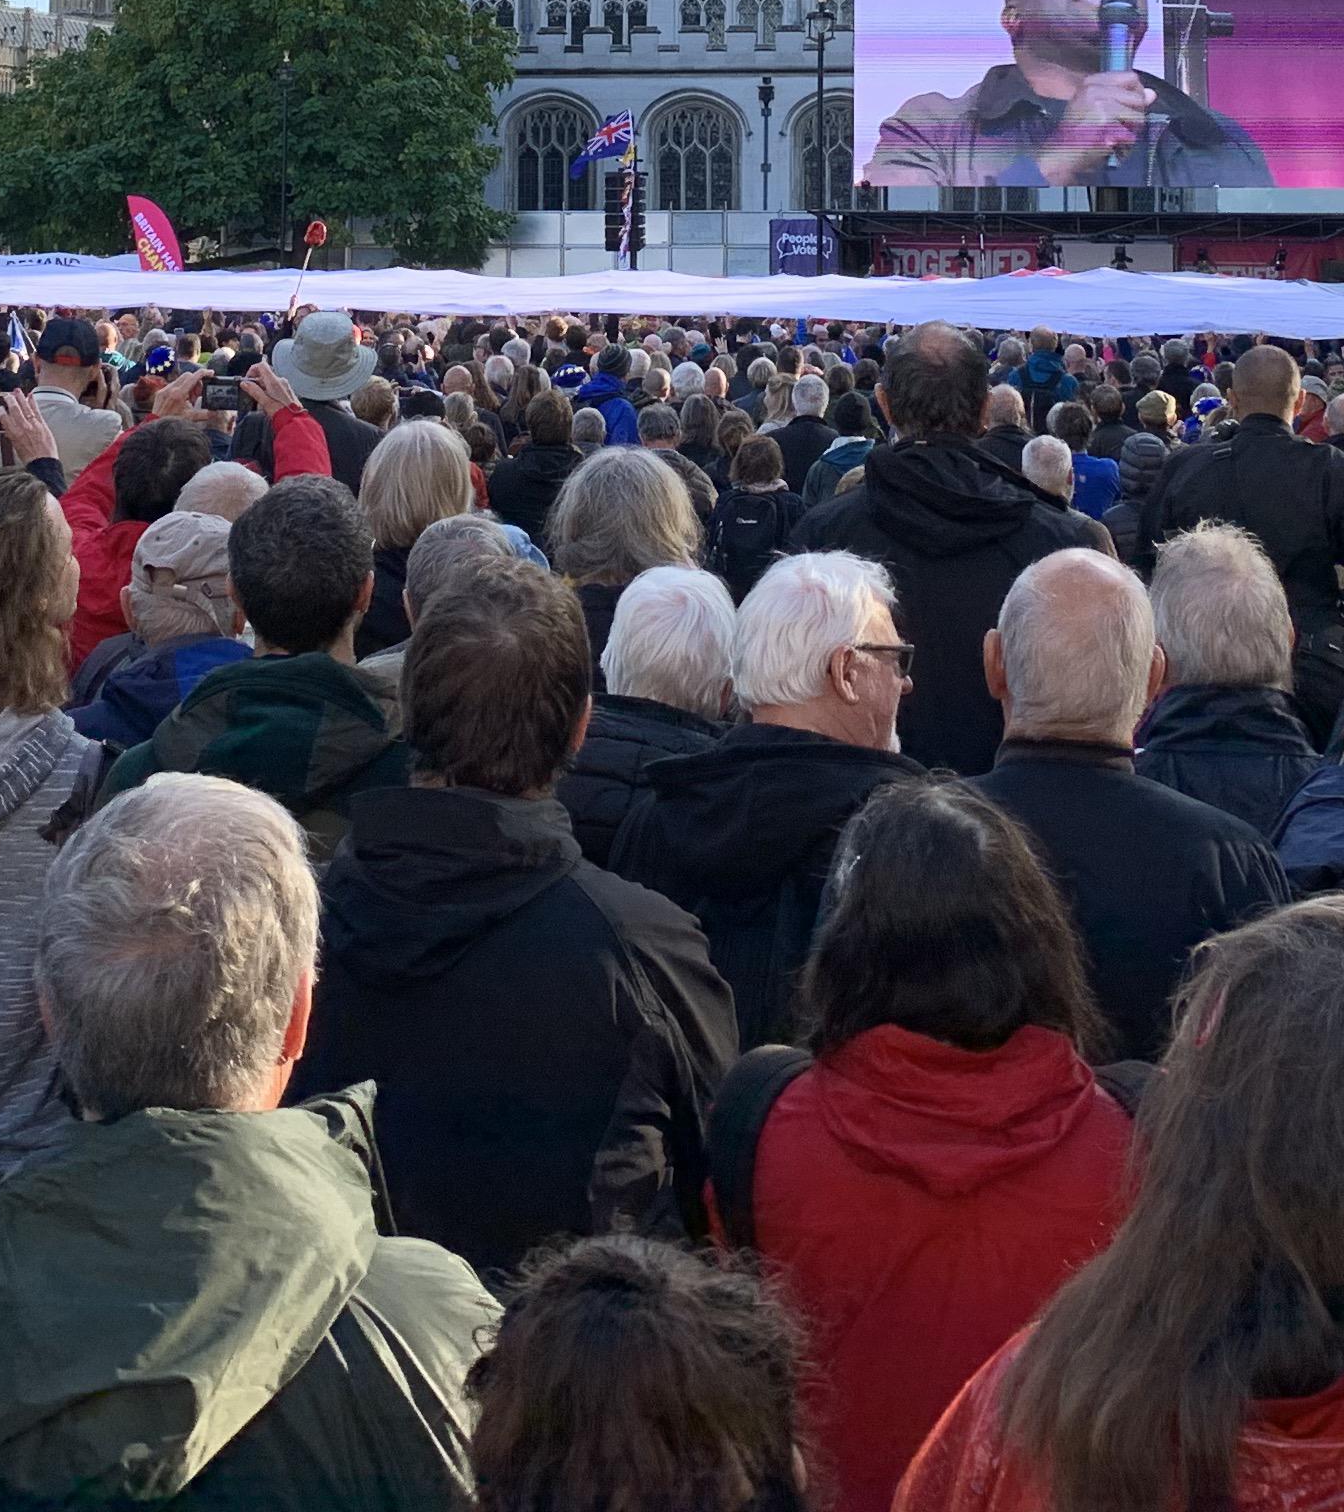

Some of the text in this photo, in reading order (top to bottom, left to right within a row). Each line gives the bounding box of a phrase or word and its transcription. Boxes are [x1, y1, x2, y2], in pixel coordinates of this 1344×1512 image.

[135, 212, 166, 253] BRITAIN
[138, 238, 168, 272] CHAN
[792, 245, 818, 256] Vote
